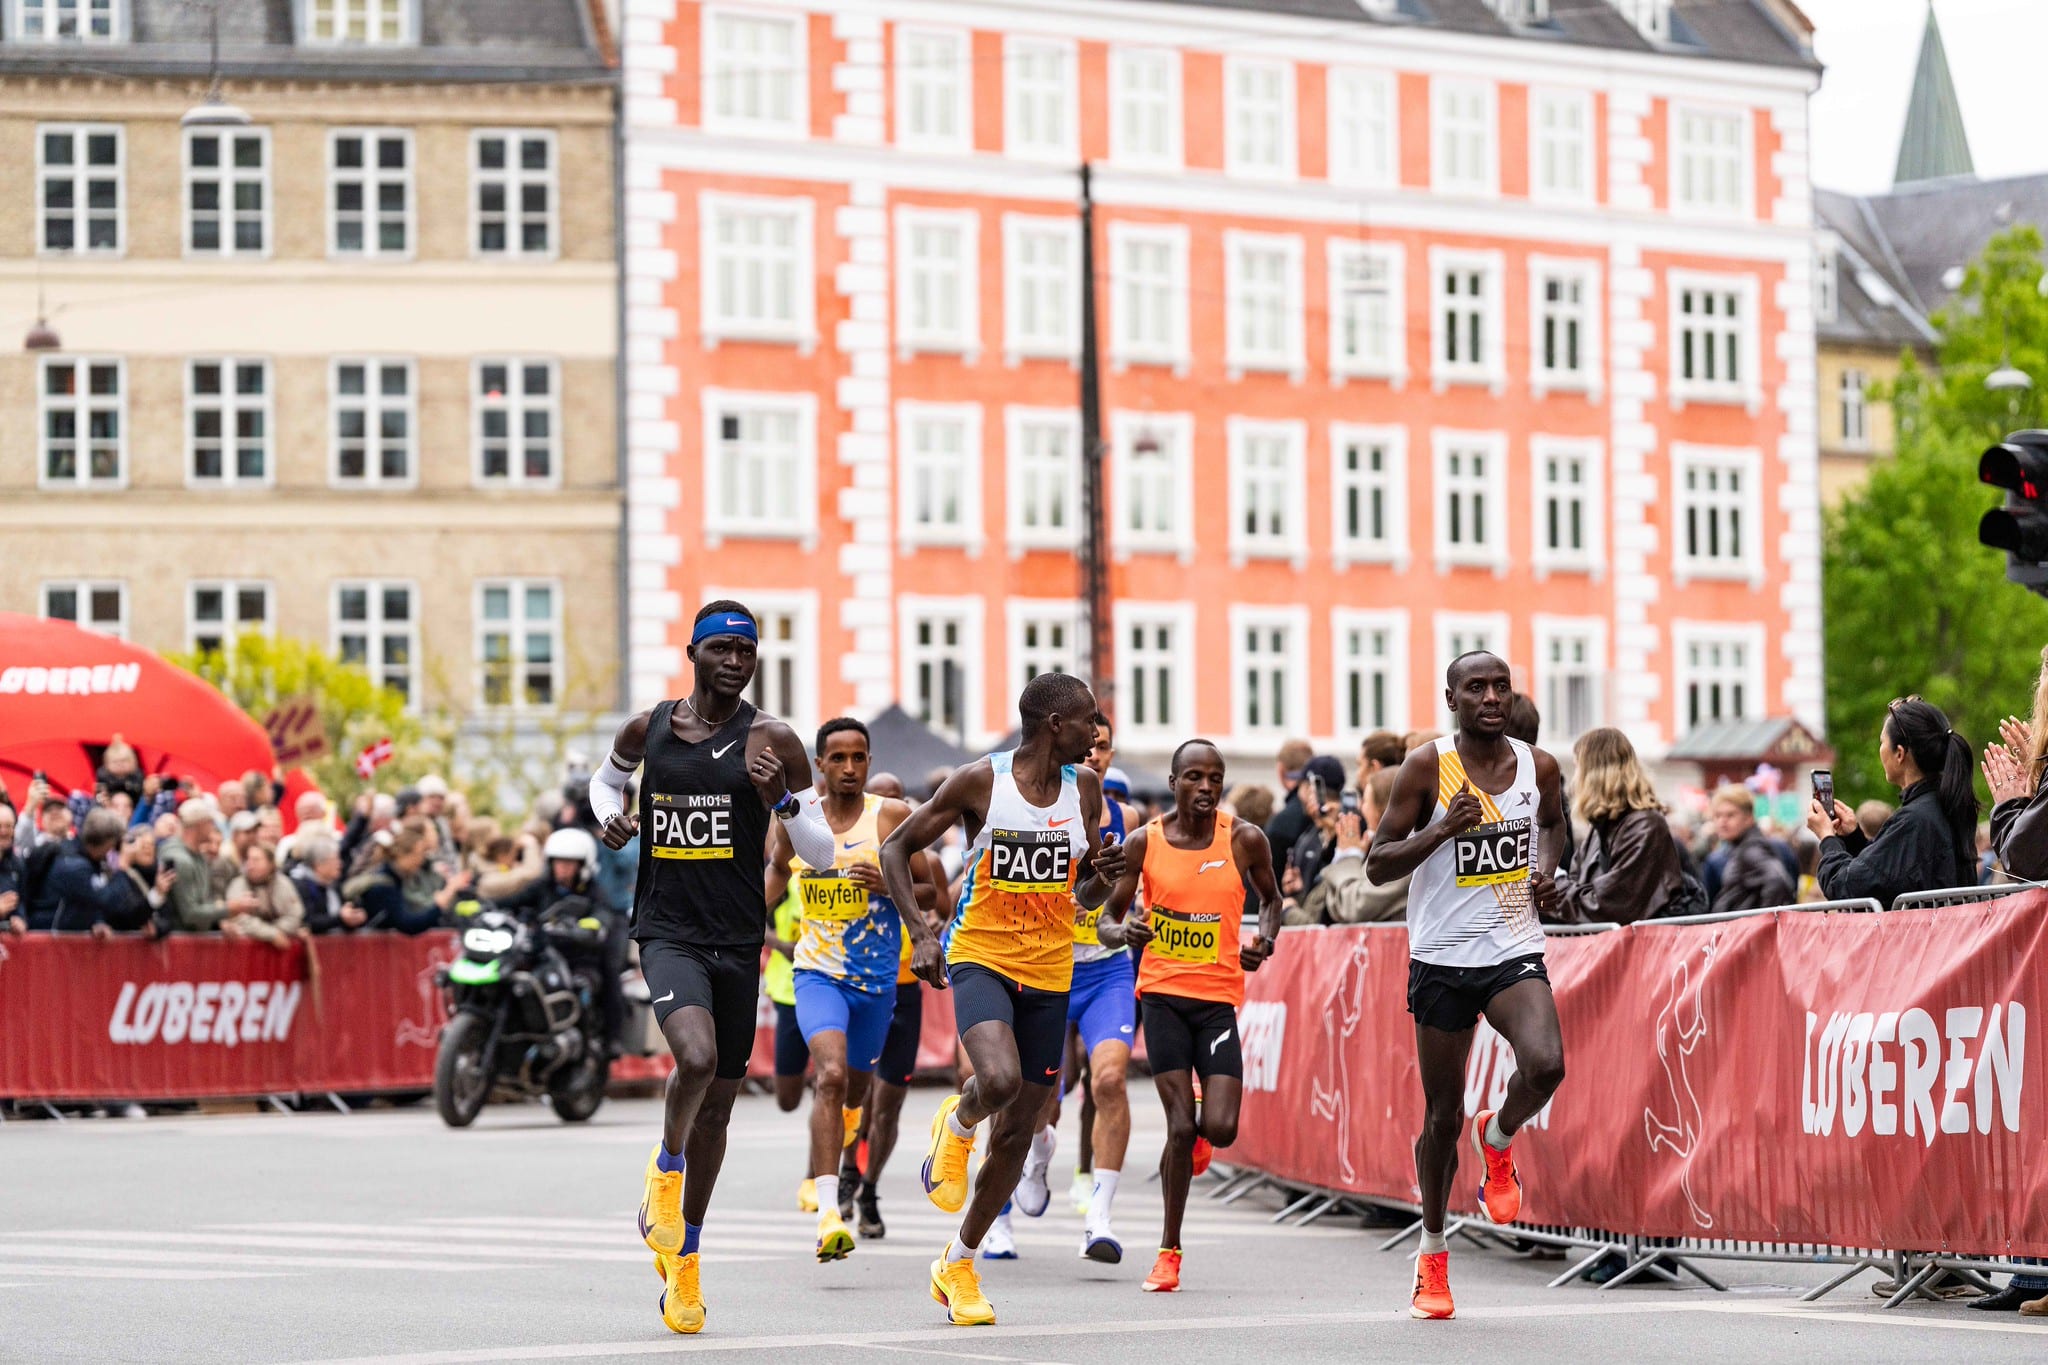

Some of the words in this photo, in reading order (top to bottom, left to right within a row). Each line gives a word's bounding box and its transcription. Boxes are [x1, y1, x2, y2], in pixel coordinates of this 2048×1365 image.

[0, 662, 140, 696] ØBEREN
[688, 795, 721, 807] M101
[653, 809, 731, 846] PACE
[1036, 832, 1062, 843] M106
[1497, 819, 1525, 832] M102
[992, 844, 1069, 880] PACE
[1457, 832, 1529, 873] PACE
[1154, 917, 1214, 951] Kiptoo
[1190, 913, 1212, 922] M20
[108, 981, 301, 1048] LØBEREN
